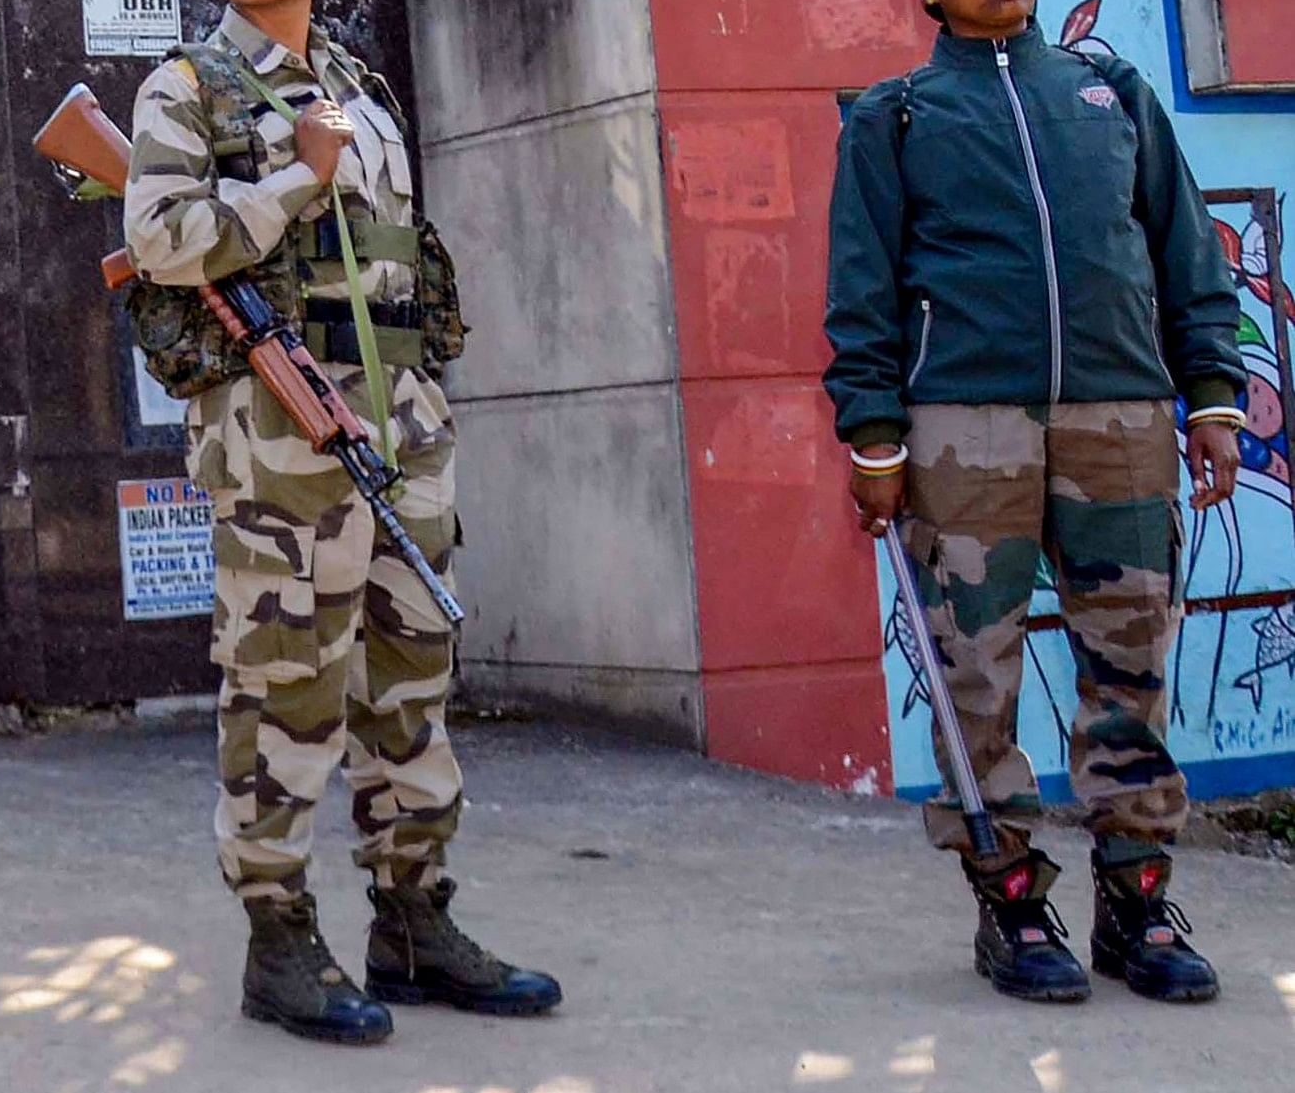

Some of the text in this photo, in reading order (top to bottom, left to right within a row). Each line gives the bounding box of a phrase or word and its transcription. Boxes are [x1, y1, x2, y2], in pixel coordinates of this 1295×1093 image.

[146, 483, 173, 503] NO
[128, 508, 165, 530] INDIAN
[131, 556, 186, 574] PACKING
